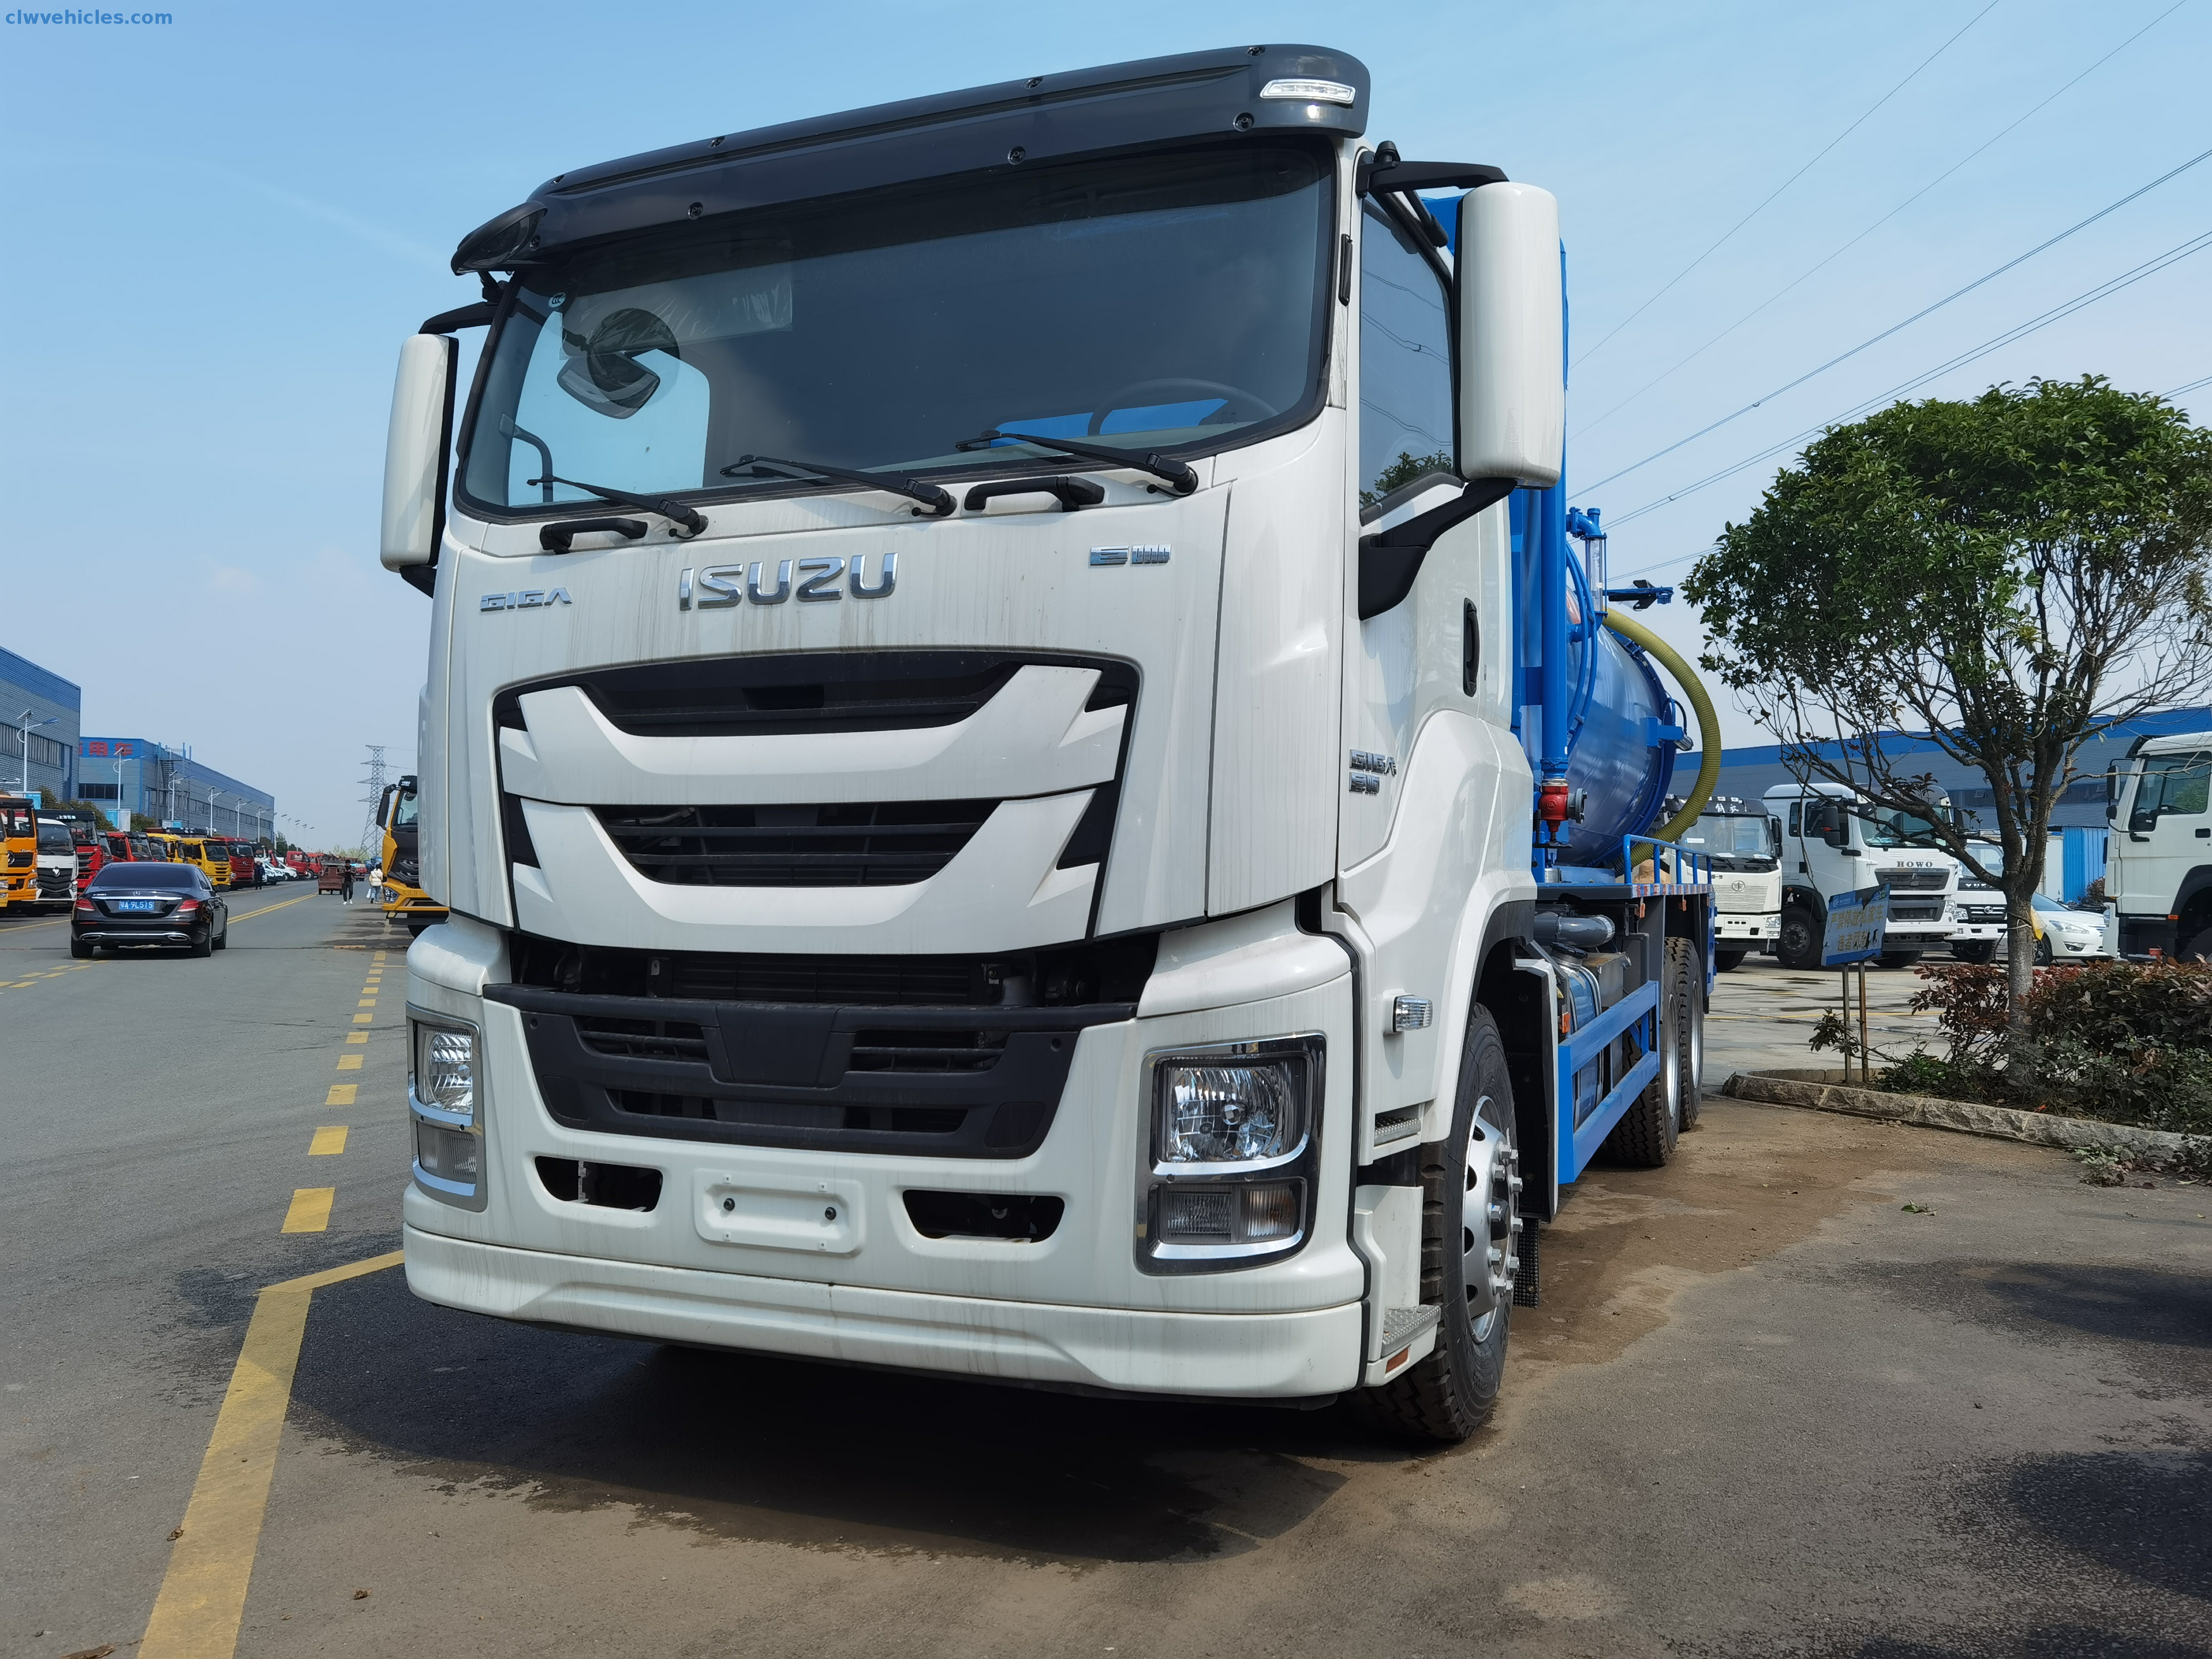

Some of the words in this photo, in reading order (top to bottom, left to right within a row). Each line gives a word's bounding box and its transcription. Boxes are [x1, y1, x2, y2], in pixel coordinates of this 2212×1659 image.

[679, 552, 899, 611] ISUZU
[480, 587, 573, 612] GIGA
[79, 741, 133, 756] 用车
[1349, 748, 1397, 778] GIGA
